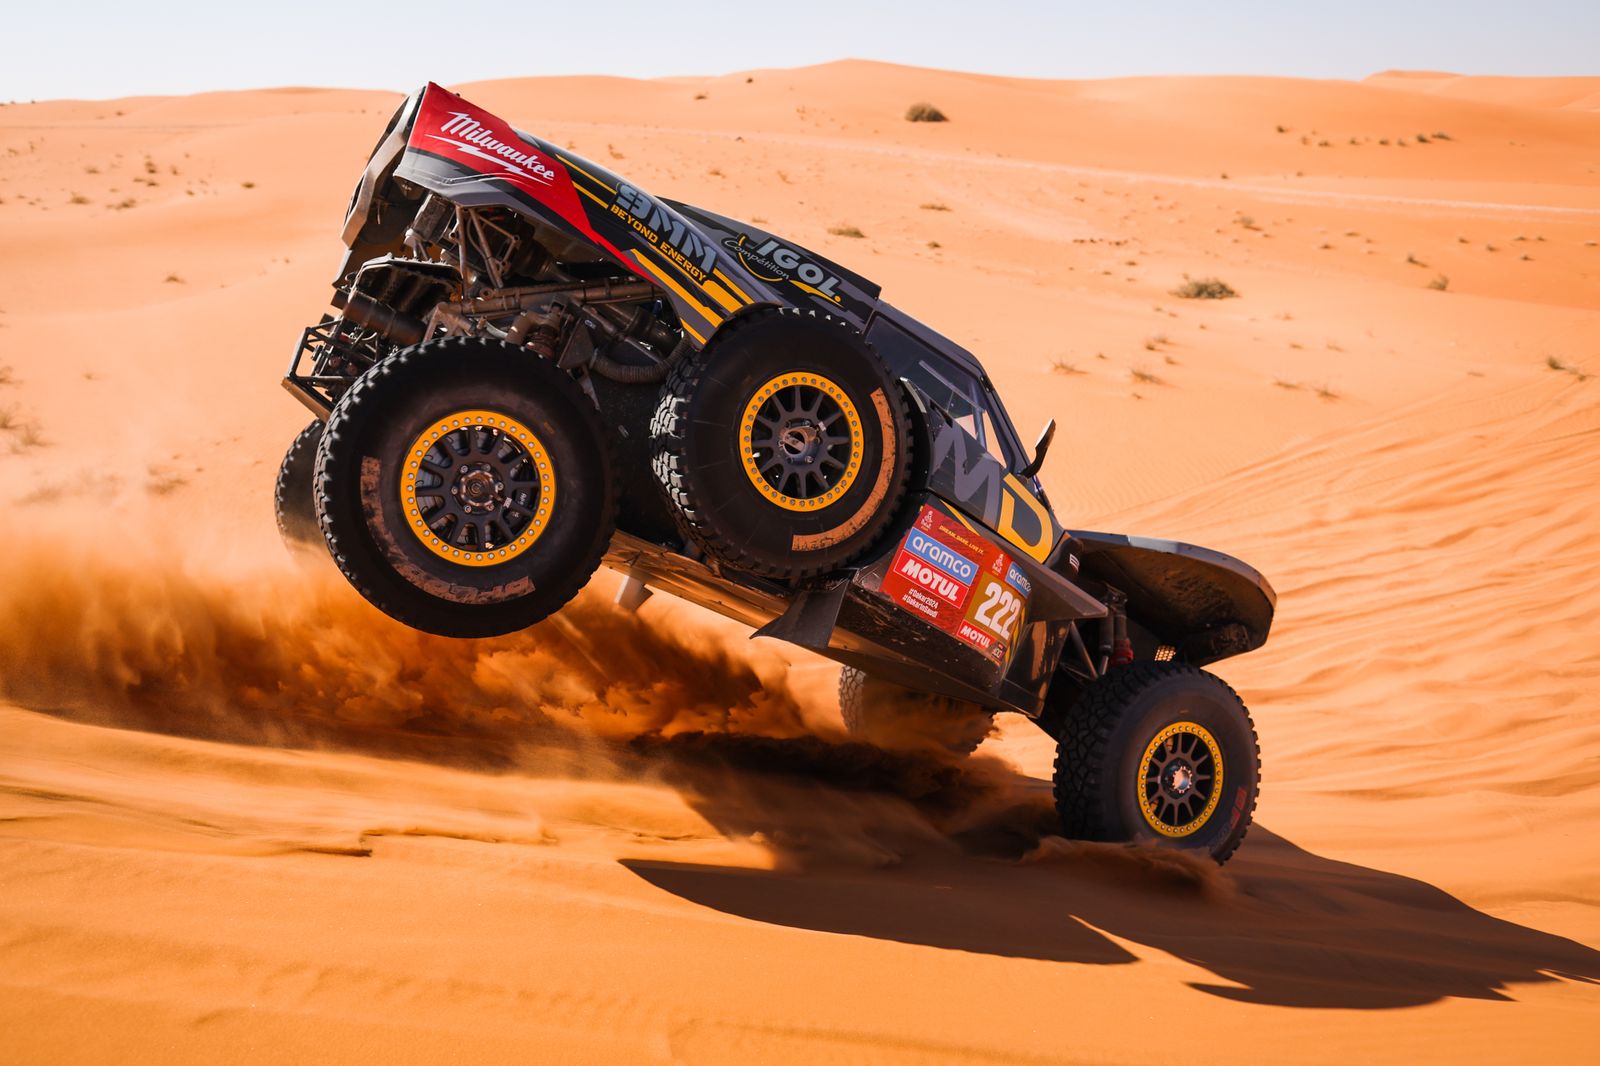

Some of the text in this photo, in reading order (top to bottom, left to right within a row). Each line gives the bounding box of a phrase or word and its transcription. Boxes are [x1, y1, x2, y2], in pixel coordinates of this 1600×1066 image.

[440, 111, 555, 181] Milwaukee
[610, 204, 707, 281] BEYOND ENERGY
[724, 240, 790, 280] Compétition
[912, 536, 972, 579] aramco
[901, 559, 959, 602] MOTUL
[974, 582, 1021, 640] 222
[960, 625, 991, 648] MOTUL
